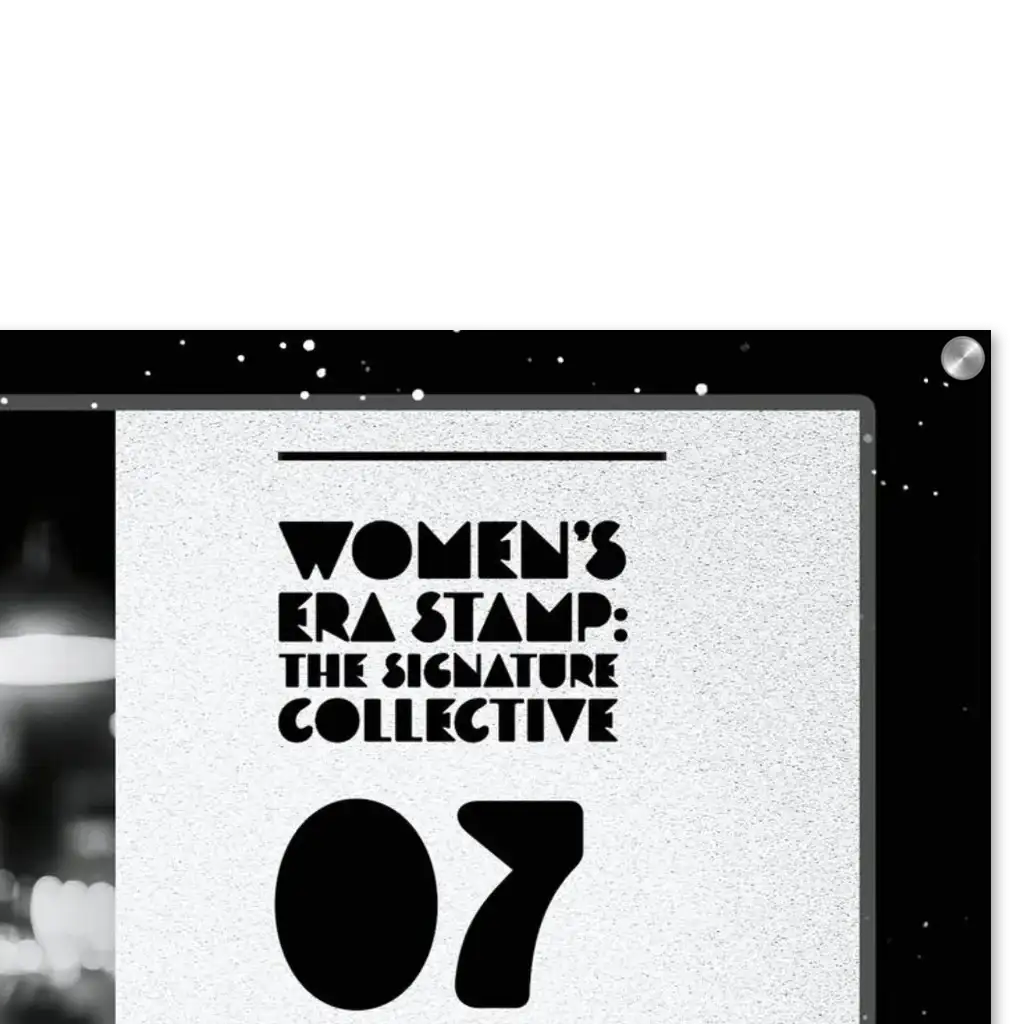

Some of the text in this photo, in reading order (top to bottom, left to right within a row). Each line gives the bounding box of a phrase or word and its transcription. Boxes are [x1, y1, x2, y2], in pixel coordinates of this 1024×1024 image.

[278, 520, 627, 581] WOMEN'S
[278, 592, 628, 643] ERA STAMP:
[278, 653, 619, 688] THE SIGNATURE
[278, 697, 618, 743] COLLECTIVE
[275, 799, 584, 1010] 07
